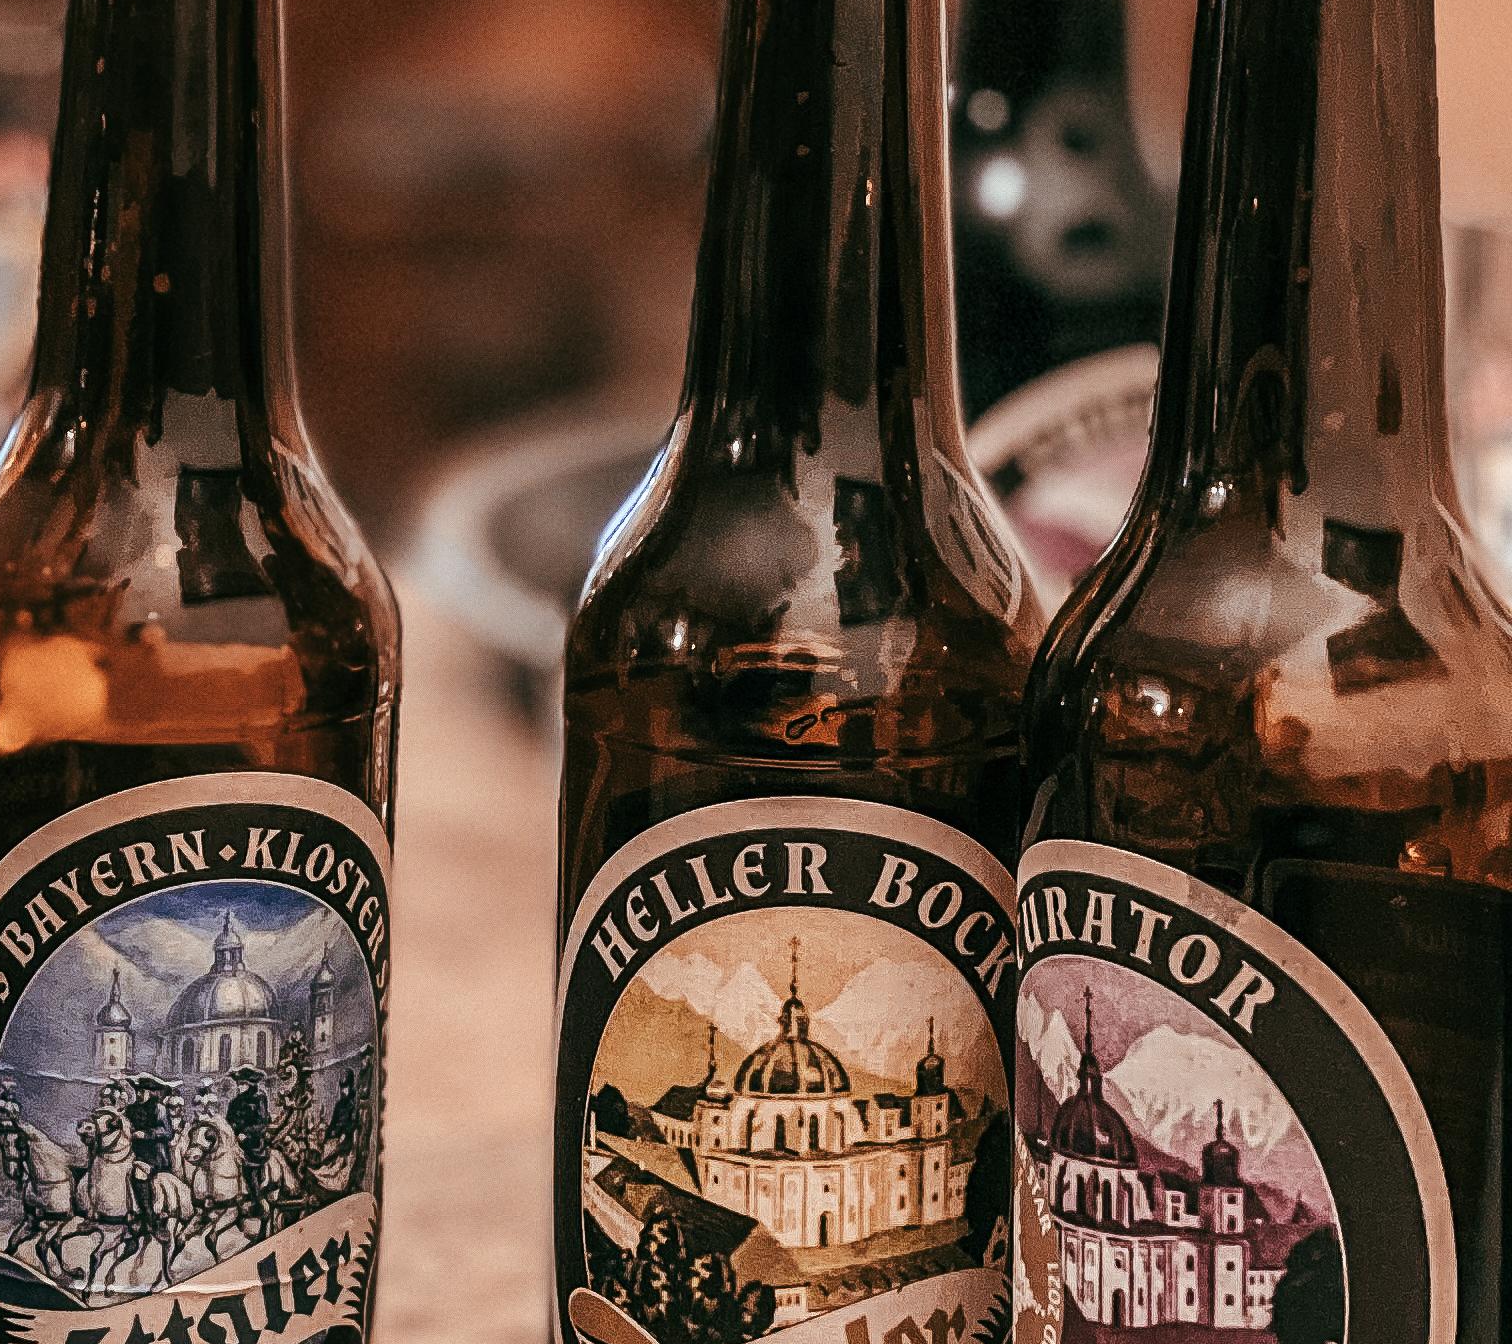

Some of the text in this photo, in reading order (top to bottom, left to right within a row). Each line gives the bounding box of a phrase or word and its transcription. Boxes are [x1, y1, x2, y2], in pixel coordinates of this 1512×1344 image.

[590, 842, 1014, 999] HELLER BOCK
[1018, 886, 1276, 1033] URATOR
